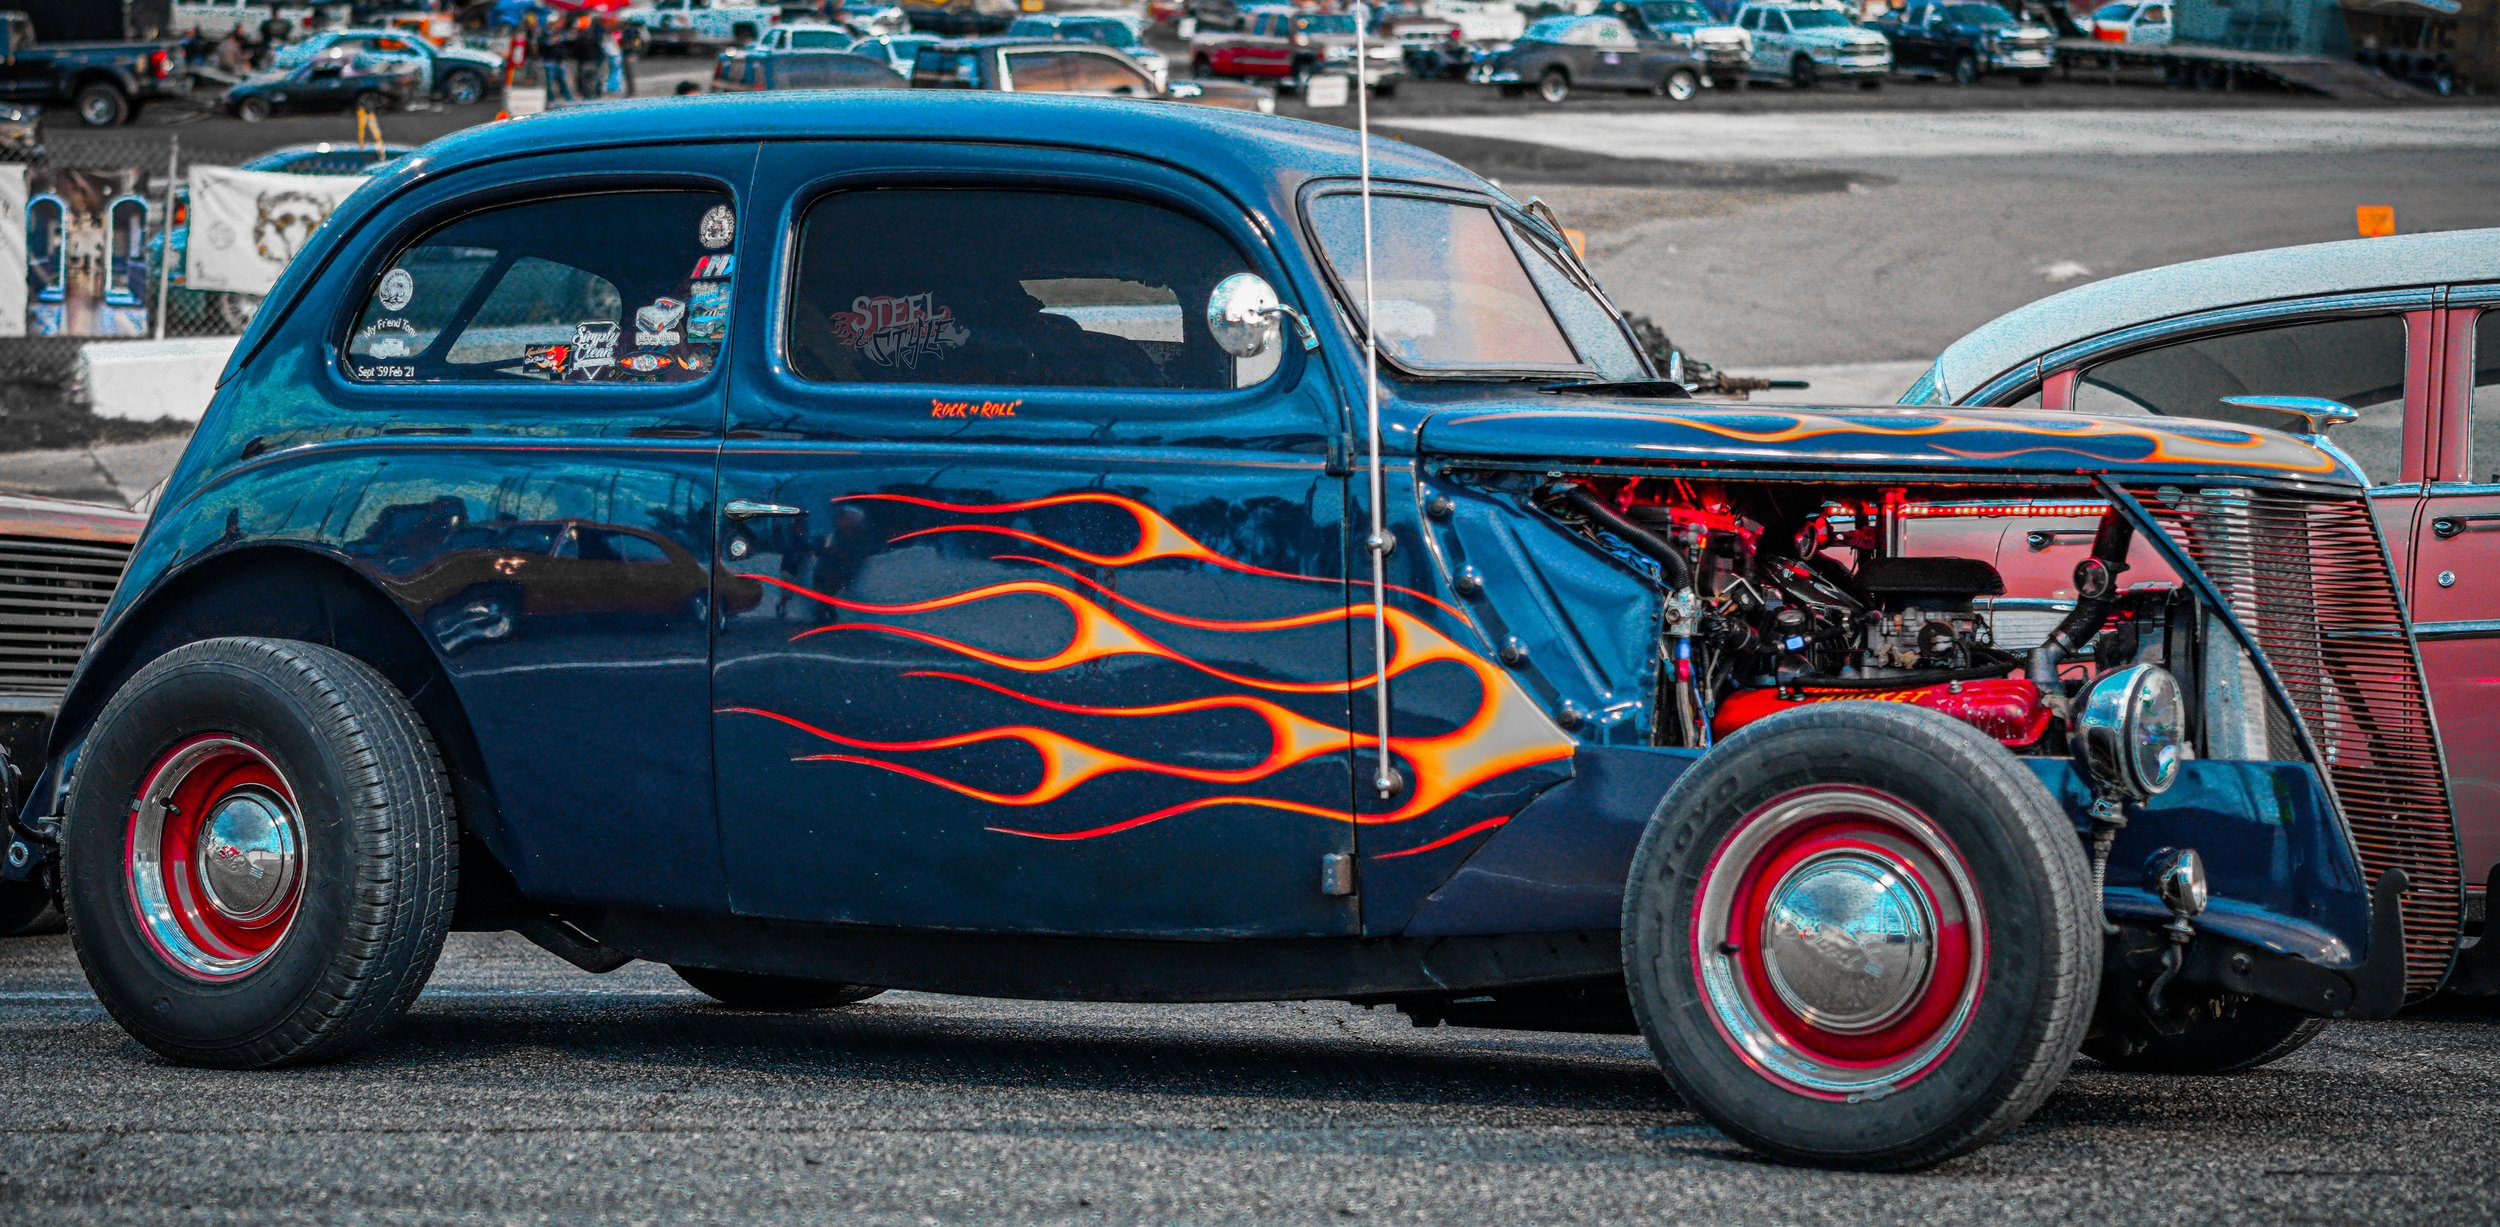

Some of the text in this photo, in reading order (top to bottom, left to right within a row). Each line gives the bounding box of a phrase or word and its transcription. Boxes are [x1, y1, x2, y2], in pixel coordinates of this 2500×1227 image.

[850, 291, 948, 333] STEEL
[363, 324, 377, 339] My
[377, 318, 402, 330] Friend
[572, 325, 620, 347] Simply
[574, 342, 613, 361] Clean
[872, 317, 956, 370] STYLE
[358, 365, 415, 378] Sept '59 Feb '21
